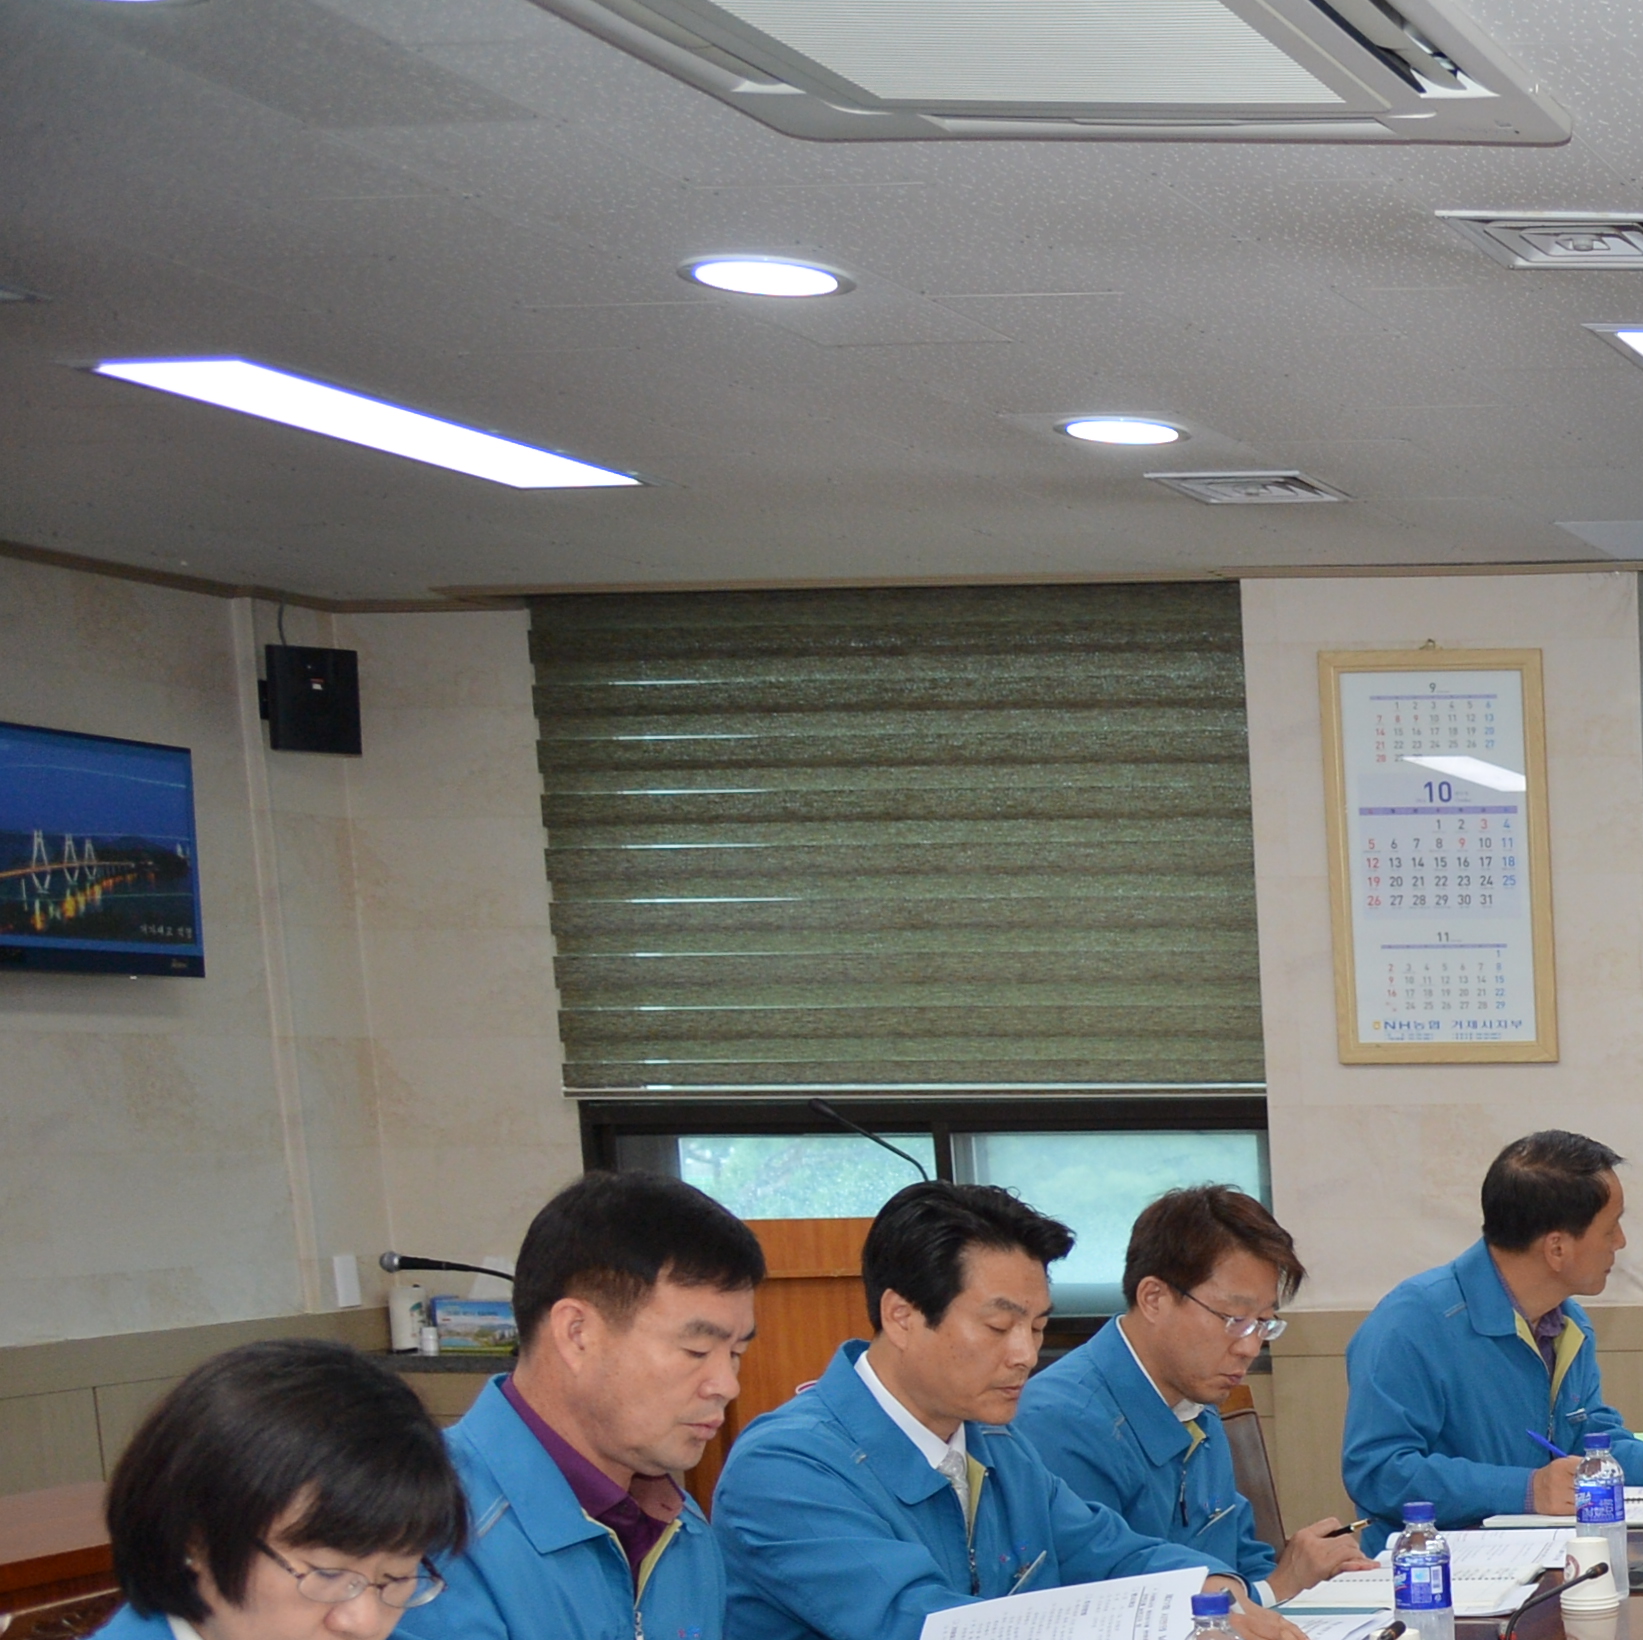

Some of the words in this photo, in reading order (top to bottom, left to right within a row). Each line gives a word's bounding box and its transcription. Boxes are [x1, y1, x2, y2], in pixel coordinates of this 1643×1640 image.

[1429, 682, 1436, 693] 9
[1429, 714, 1439, 723] 10
[1448, 714, 1457, 722] 11
[1466, 714, 1475, 722] 12
[1484, 713, 1494, 721] 13
[1375, 728, 1386, 736] 14
[1394, 727, 1404, 736] 15
[1412, 727, 1422, 736] 16
[1430, 727, 1440, 736] 17
[1448, 727, 1458, 736] 18
[1466, 727, 1476, 735] 19
[1484, 726, 1495, 735] 20
[1375, 741, 1385, 750] 21
[1394, 741, 1404, 750] 22
[1412, 741, 1422, 749] 23
[1430, 740, 1440, 749] 24
[1448, 740, 1458, 749] 25
[1466, 740, 1477, 749] 26
[1485, 739, 1495, 749] 27
[1376, 754, 1386, 763] 28
[1423, 781, 1453, 803] 10
[1436, 819, 1441, 830] 1
[1458, 819, 1465, 830] 2
[1480, 819, 1488, 829] 3
[1503, 819, 1511, 829] 4
[1368, 839, 1375, 850] 5
[1390, 839, 1398, 849] 6
[1413, 838, 1421, 849] 7
[1435, 838, 1443, 849] 8
[1458, 838, 1466, 848] 9
[1479, 837, 1492, 848] 10
[1501, 837, 1514, 848] 11
[1366, 858, 1380, 869] 12
[1389, 857, 1402, 868] 13
[1411, 857, 1425, 868] 14
[1434, 857, 1447, 868] 15
[1457, 857, 1470, 868] 16
[1479, 856, 1492, 867] 17
[1502, 856, 1515, 867] 18
[1367, 877, 1381, 887] 19
[1389, 876, 1403, 887] 20
[1412, 876, 1425, 887] 21
[1434, 876, 1448, 887] 22
[1457, 875, 1471, 887] 23
[1480, 875, 1494, 886] 24
[1502, 875, 1516, 886] 25
[1367, 895, 1382, 906] 26
[1390, 895, 1403, 906] 27
[1412, 895, 1426, 906] 28
[1435, 895, 1449, 905] 29
[1457, 894, 1471, 905] 30
[1480, 894, 1493, 905] 31
[1437, 932, 1450, 942] 11
[1404, 976, 1414, 985] 10
[1422, 976, 1432, 984] 11
[1441, 976, 1450, 984] 12
[1458, 976, 1469, 984] 13
[1476, 976, 1486, 984] 14
[1494, 975, 1505, 984] 15
[1387, 989, 1397, 998] 16
[1405, 989, 1415, 997] 17
[1423, 989, 1433, 997] 18
[1441, 989, 1451, 997] 19
[1459, 988, 1469, 997] 20
[1477, 988, 1487, 997] 21
[1495, 988, 1505, 997] 22
[1405, 1002, 1416, 1010] 24
[1423, 1002, 1434, 1010] 25
[1441, 1002, 1452, 1010] 26
[1459, 1001, 1470, 1010] 27
[1477, 1001, 1488, 1010] 28
[1495, 1001, 1506, 1010] 29
[1384, 1020, 1440, 1030] NH농협
[1452, 1020, 1522, 1029] 거제시지부
